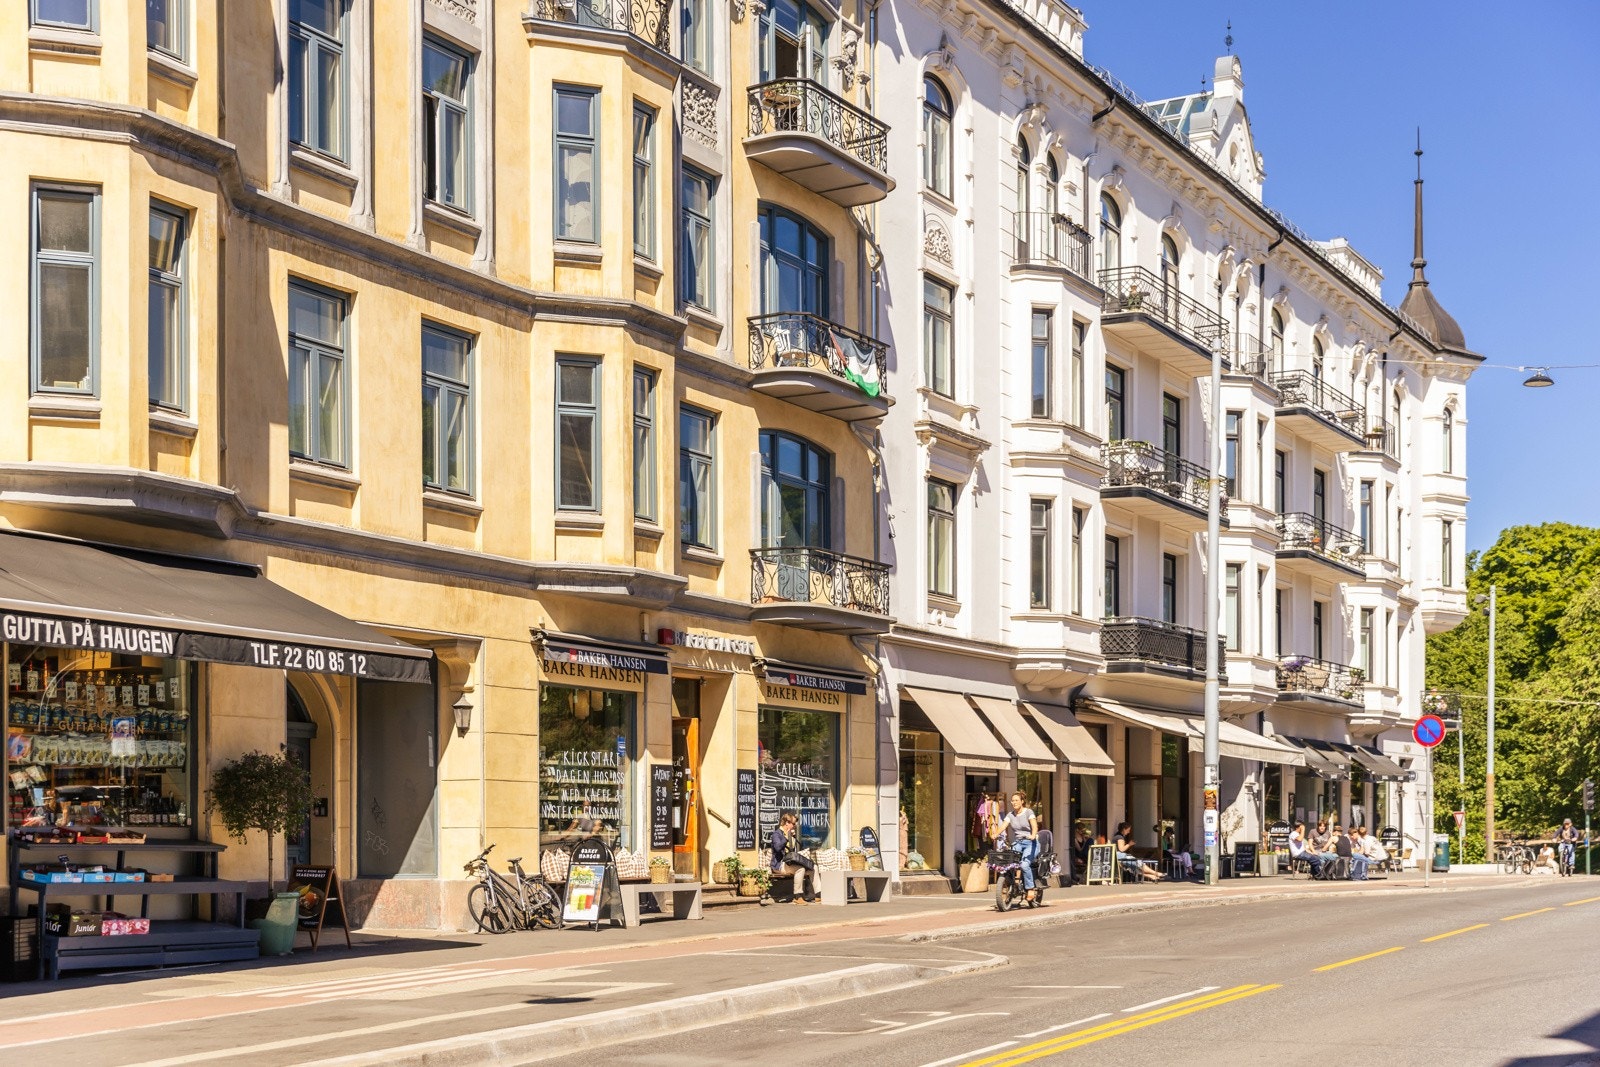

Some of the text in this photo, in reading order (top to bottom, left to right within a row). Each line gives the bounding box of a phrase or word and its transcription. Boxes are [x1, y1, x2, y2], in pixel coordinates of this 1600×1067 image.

[3, 614, 174, 655] GUTTA PÅ HAUGEN
[251, 642, 366, 675] TLF. 22 60 85 12
[578, 650, 647, 670] BAKER HANSEN
[543, 659, 642, 683] BAKER HANSEN
[796, 674, 846, 691] BAKER HANSEN
[766, 685, 840, 705] BAKER HANSEN
[556, 769, 625, 785] DAGEN HOS OSS
[561, 788, 580, 802] MED
[585, 788, 612, 802] KAFFE
[782, 796, 804, 809] STORE
[541, 804, 579, 819] NYSTEKT
[75, 923, 97, 933] Junior
